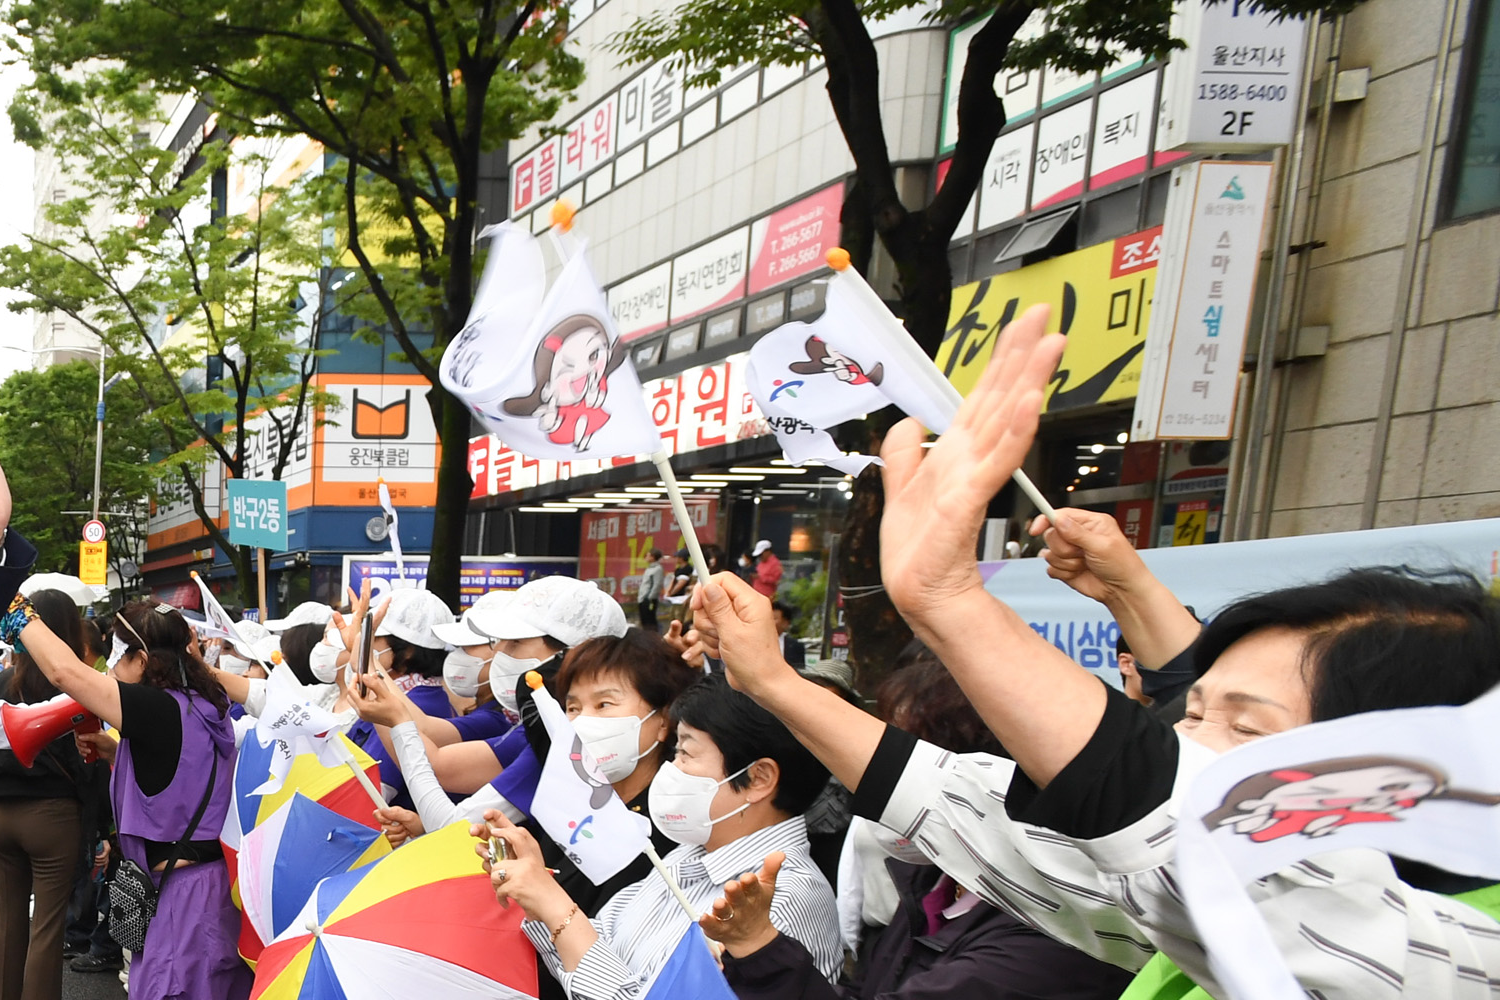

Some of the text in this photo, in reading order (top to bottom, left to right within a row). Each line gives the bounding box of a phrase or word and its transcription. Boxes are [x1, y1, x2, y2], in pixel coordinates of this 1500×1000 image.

[1212, 45, 1286, 67] 울산지사
[1197, 83, 1288, 101] 1588-6400
[1220, 110, 1255, 136] 2F
[676, 249, 743, 301] 복지연합회
[1106, 277, 1152, 337] 미
[348, 447, 410, 468] 웅진북클럽
[232, 495, 281, 533] 반구2동
[587, 517, 620, 541] 서울대
[625, 510, 662, 538] 홍익대
[88, 527, 100, 537] 50
